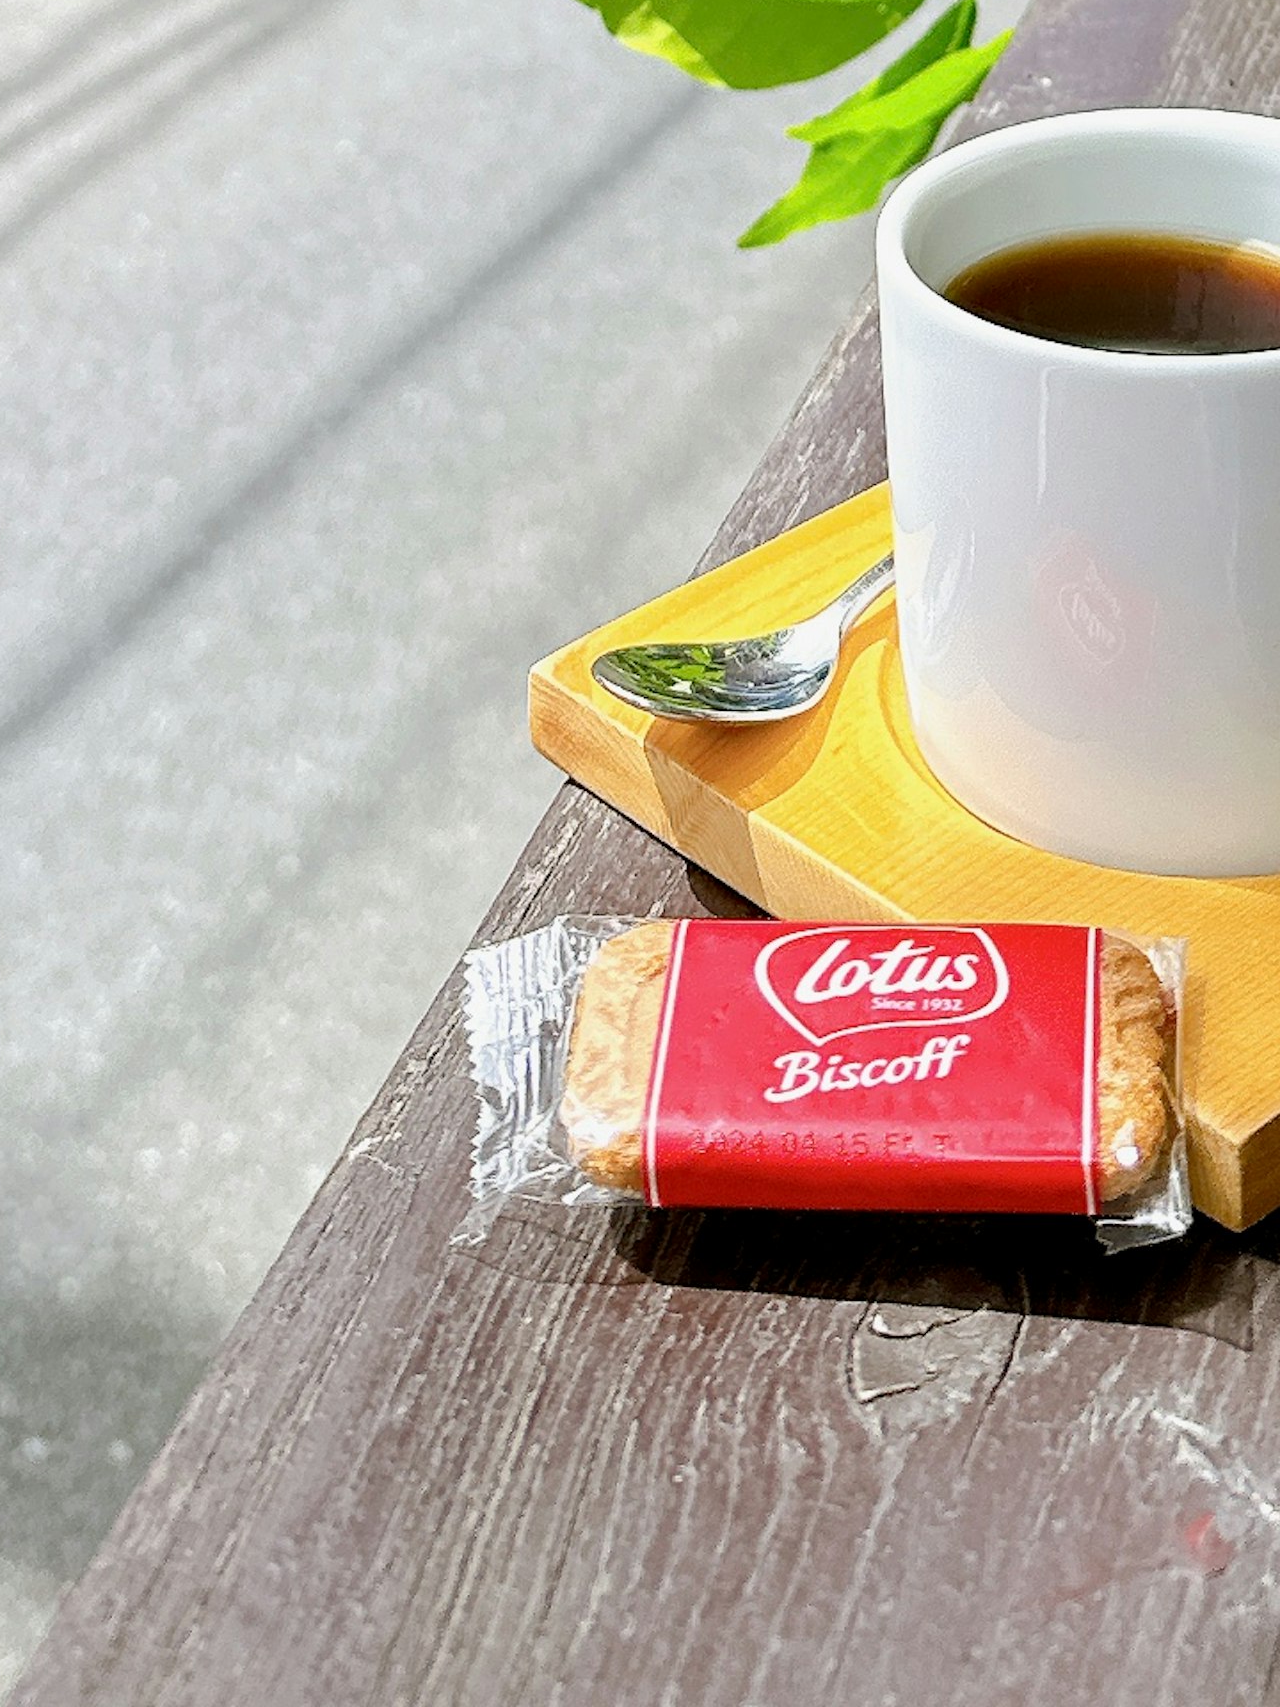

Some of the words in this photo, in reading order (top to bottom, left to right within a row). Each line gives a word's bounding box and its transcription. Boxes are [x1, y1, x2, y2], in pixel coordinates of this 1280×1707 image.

[794, 938, 980, 1004] Lotus
[870, 996, 916, 1011] Since
[922, 998, 964, 1011] 1932
[763, 1034, 972, 1104] Biscoff
